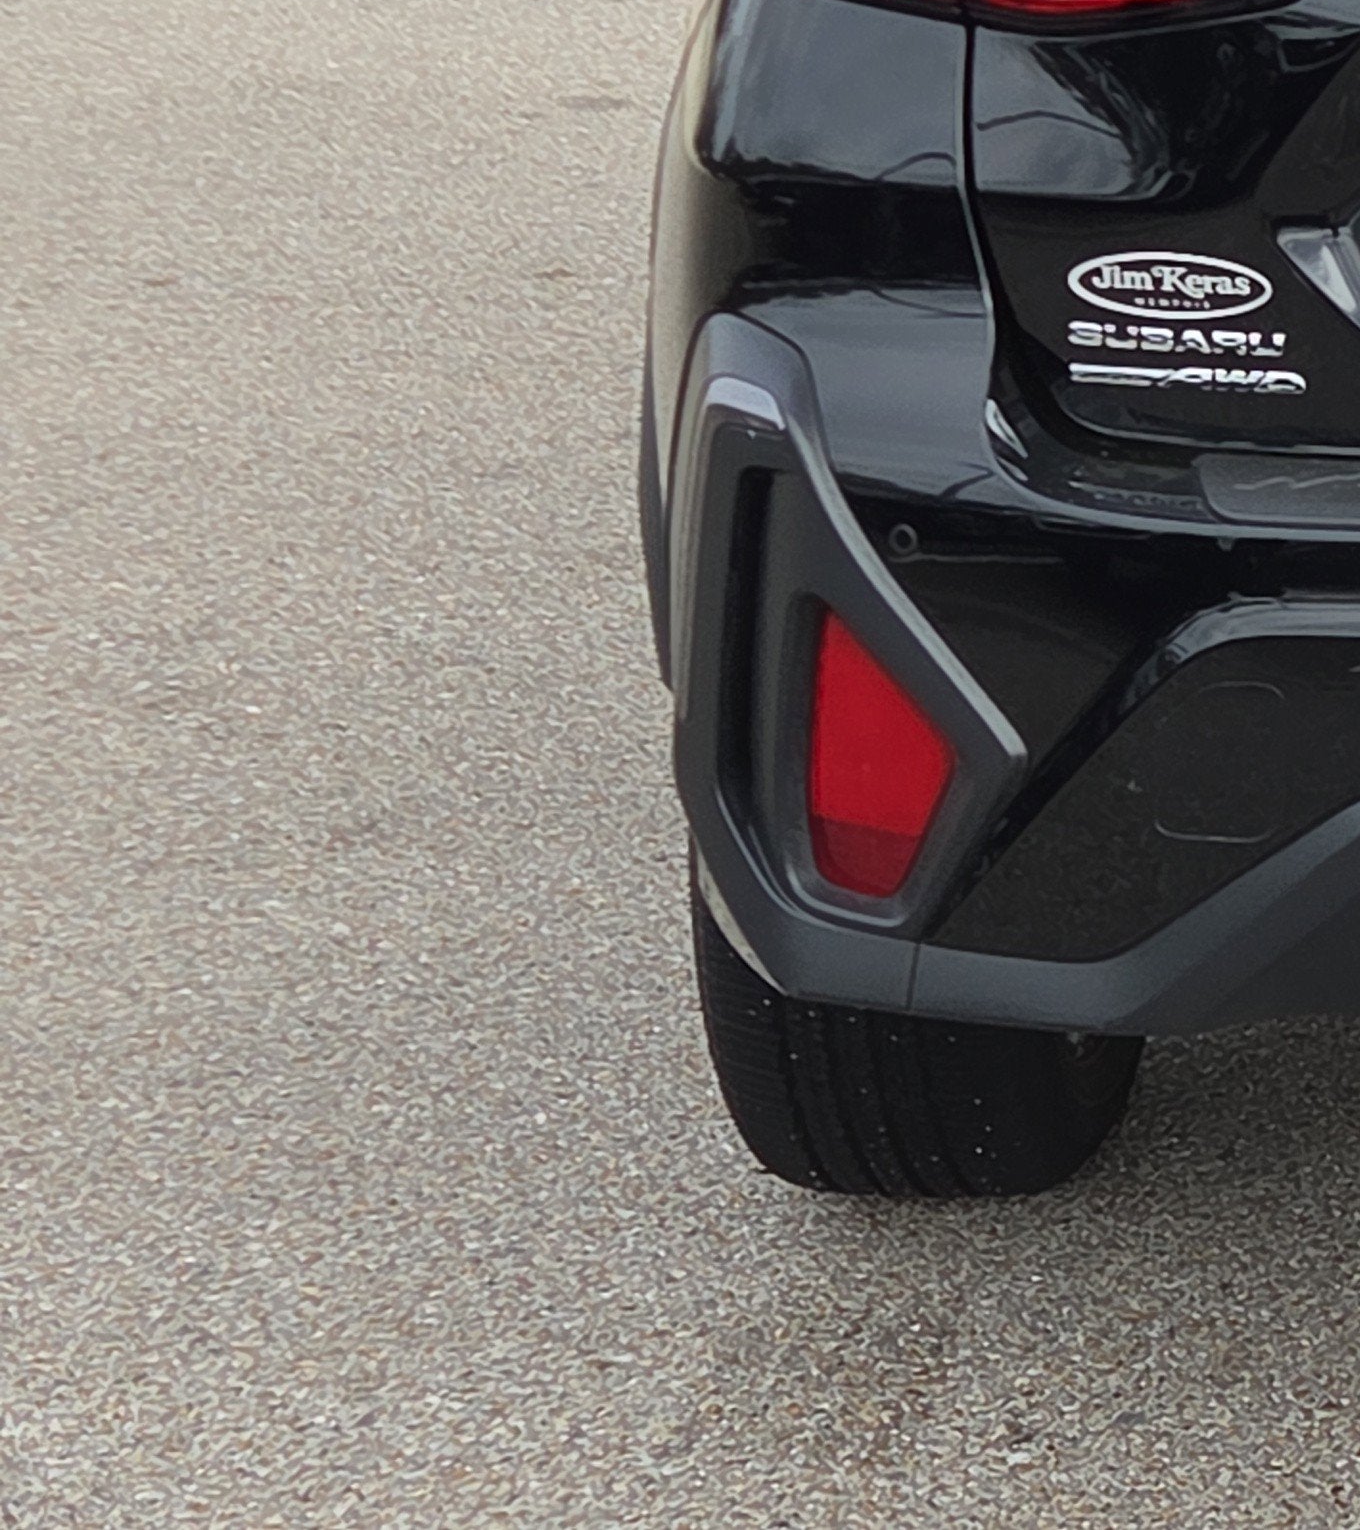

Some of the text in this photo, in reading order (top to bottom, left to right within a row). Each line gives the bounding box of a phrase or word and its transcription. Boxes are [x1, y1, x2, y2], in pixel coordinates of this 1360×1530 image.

[1092, 265, 1251, 298] Jim Keras
[1068, 321, 1286, 356] SUBARU
